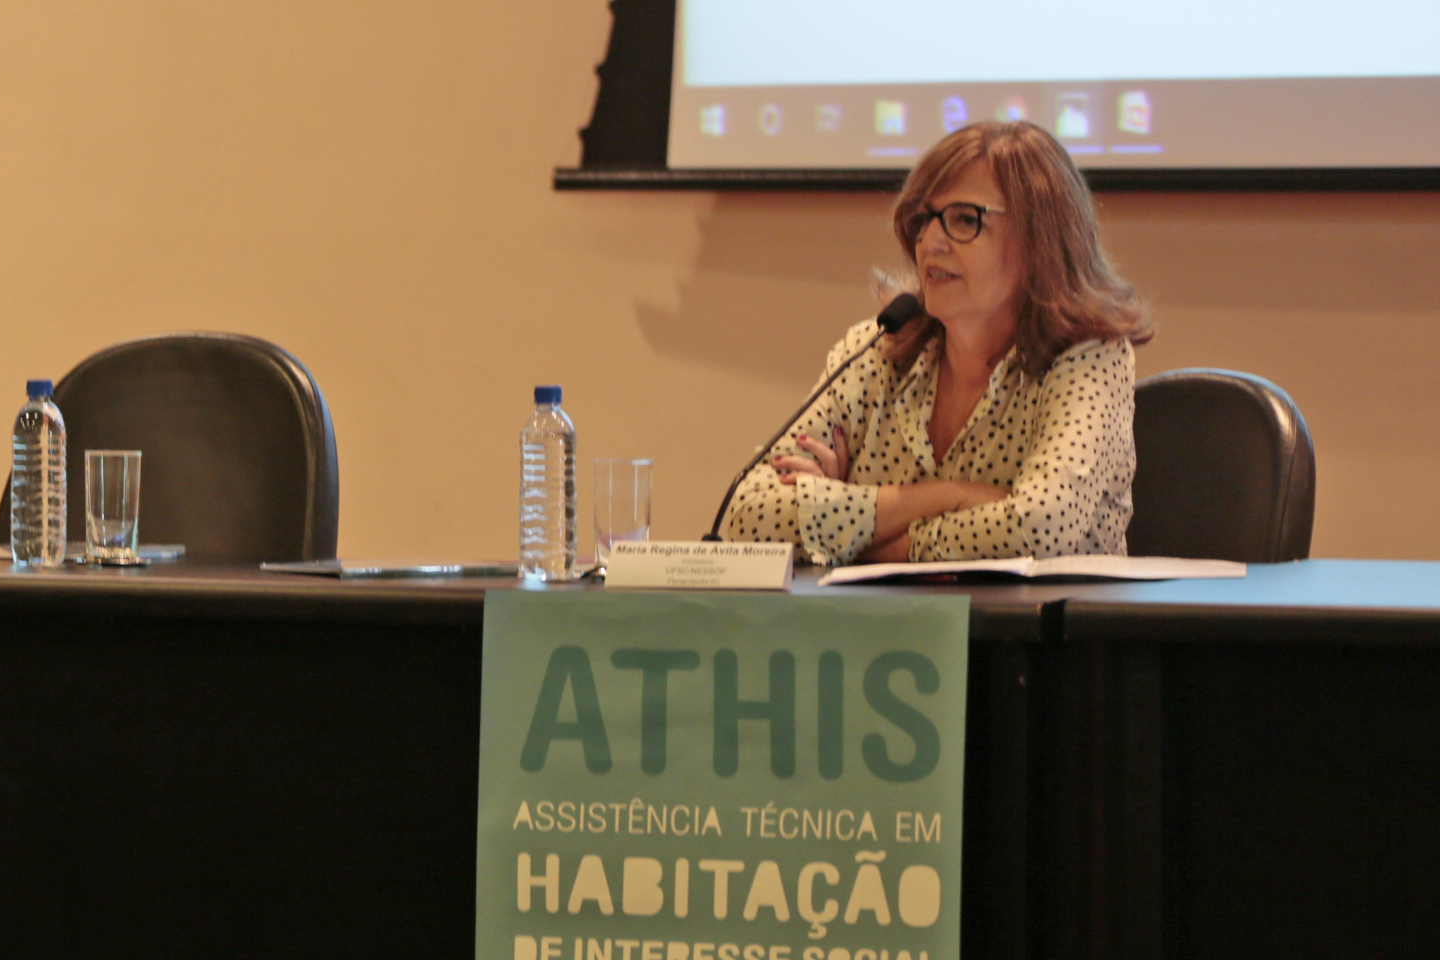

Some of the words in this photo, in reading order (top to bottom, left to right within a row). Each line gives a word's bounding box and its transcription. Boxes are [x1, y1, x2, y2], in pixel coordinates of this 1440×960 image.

[615, 544, 647, 555] Maria
[650, 544, 690, 557] Regina
[692, 545, 707, 555] de
[742, 545, 786, 556] Moreira
[519, 644, 941, 783] ATHIS
[513, 798, 721, 837] ASSISTÊNCIA
[741, 802, 878, 840] TÉCNICA
[896, 811, 942, 843] EM
[516, 849, 941, 939] HABITAÇÃO
